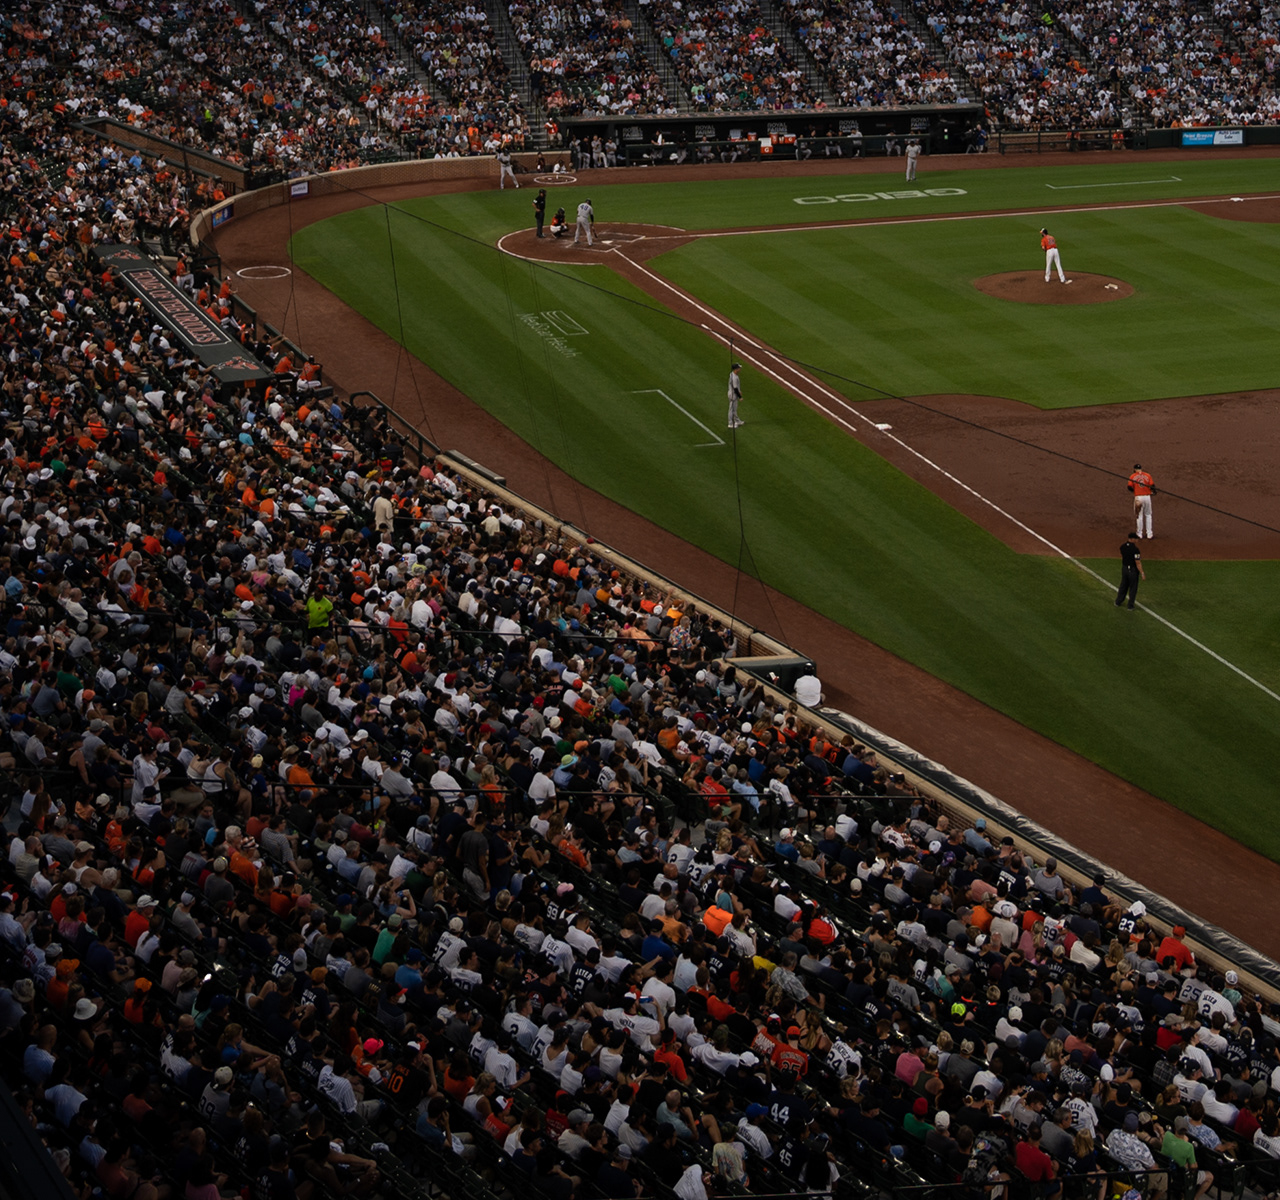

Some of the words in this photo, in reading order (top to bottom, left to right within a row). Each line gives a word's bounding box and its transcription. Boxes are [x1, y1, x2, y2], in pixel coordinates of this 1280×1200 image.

[792, 188, 968, 205] GEICO
[171, 312, 221, 344] ORIOLES
[669, 853, 678, 864] 2
[686, 863, 702, 881] 23
[546, 904, 559, 920] 99
[1119, 917, 1136, 932] 23
[1043, 925, 1058, 942] 99
[574, 967, 594, 981] JETER
[575, 979, 585, 994] 2
[1181, 984, 1201, 1001] 25
[1202, 992, 1218, 1005] JETER
[1201, 1003, 1211, 1015] 2
[510, 1023, 520, 1039] 2
[827, 1052, 843, 1070] 24
[387, 1072, 404, 1094] 10
[770, 1101, 790, 1125] 44
[779, 1148, 793, 1167] 45
